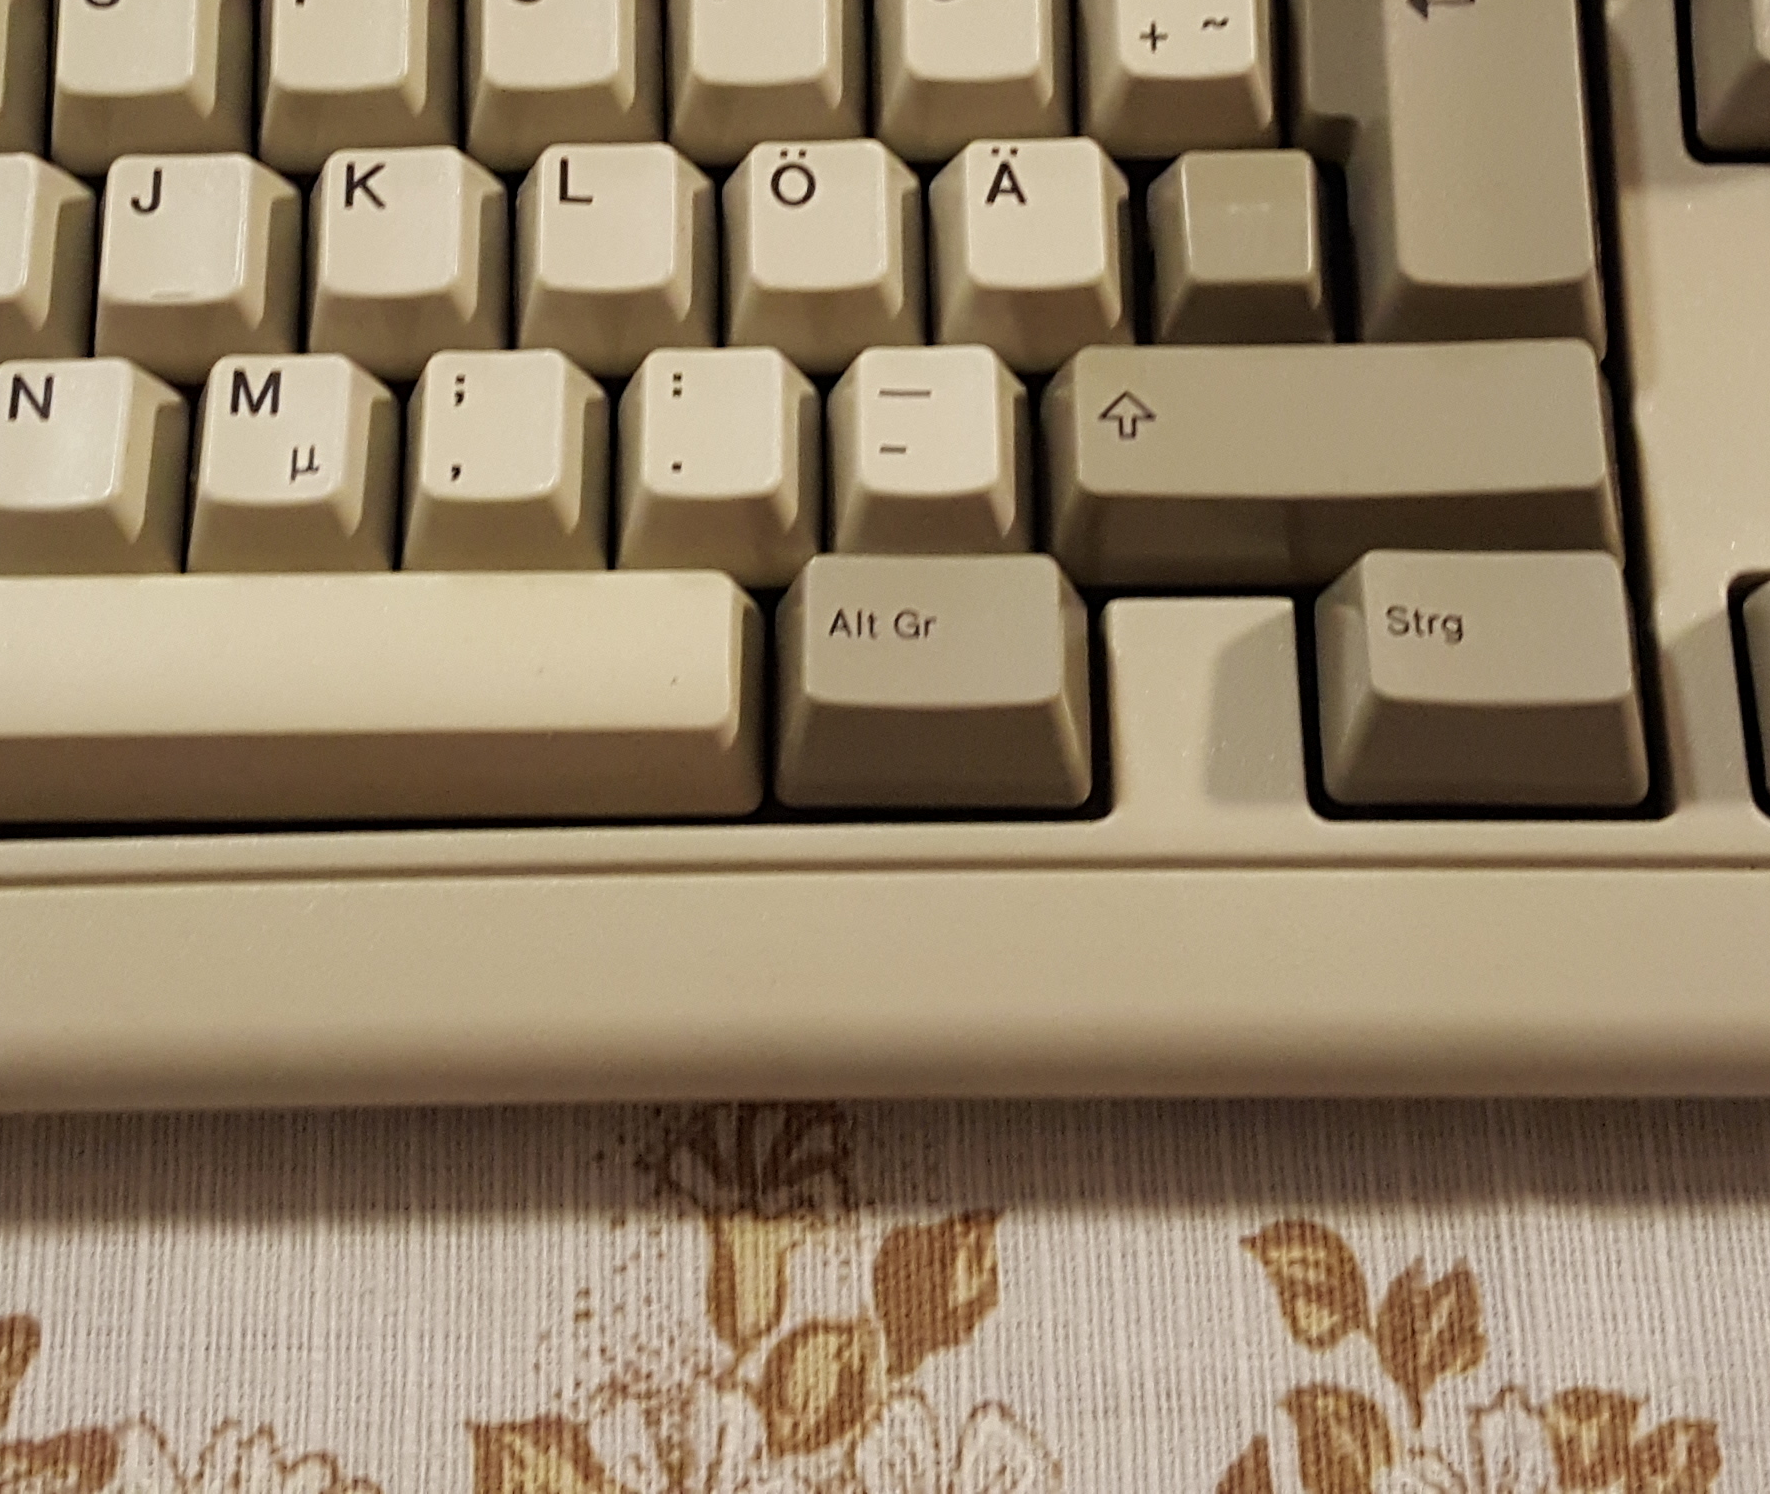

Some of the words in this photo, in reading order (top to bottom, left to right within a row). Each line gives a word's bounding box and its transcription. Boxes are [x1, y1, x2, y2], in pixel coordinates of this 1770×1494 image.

[130, 167, 163, 215] J
[344, 161, 385, 209] K
[558, 157, 593, 205] L
[770, 149, 817, 208] Ö
[985, 147, 1027, 205] Ä
[8, 373, 54, 421] N
[229, 368, 282, 416] M
[828, 608, 876, 639] Alt
[893, 609, 937, 640] Gr
[1385, 605, 1465, 646] Strg
